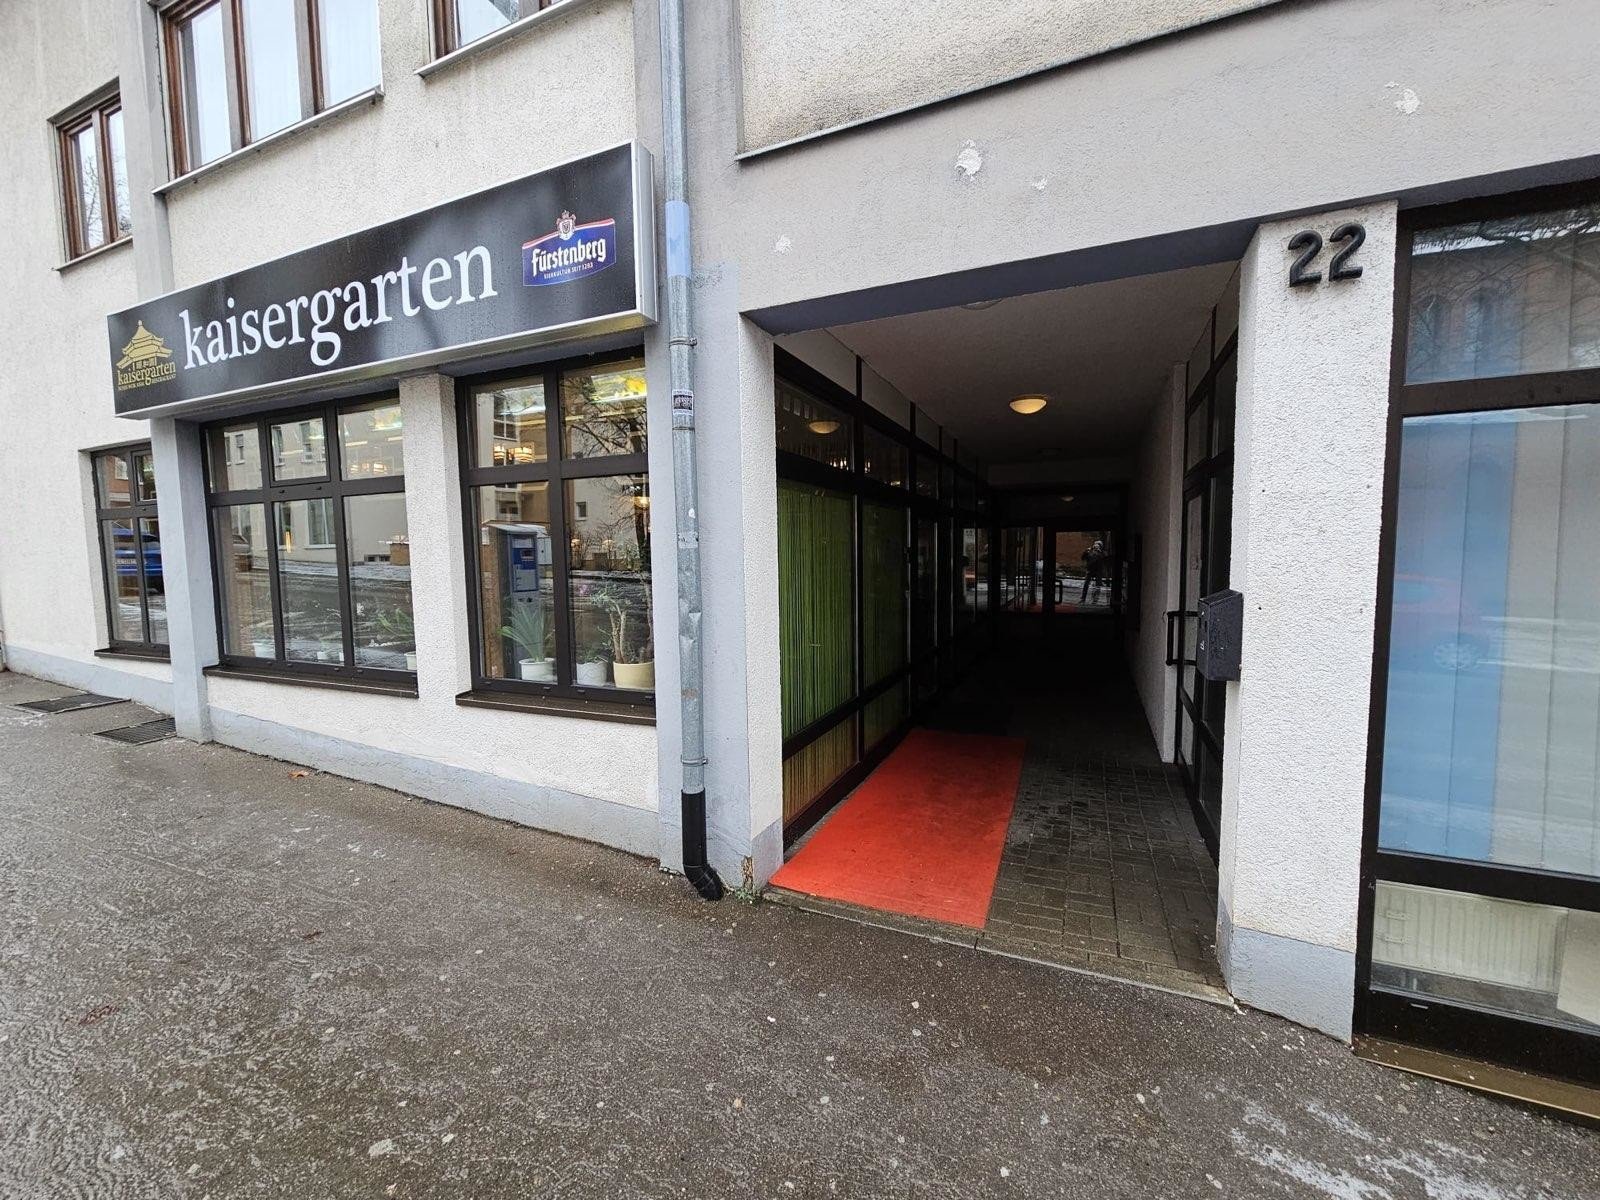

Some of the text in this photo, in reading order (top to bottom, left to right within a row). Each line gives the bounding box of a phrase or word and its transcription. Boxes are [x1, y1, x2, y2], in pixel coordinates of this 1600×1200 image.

[531, 238, 606, 277] Fürstenberg
[1288, 222, 1366, 287] 22
[179, 245, 497, 366] kaisergarten
[117, 361, 176, 386] kaisergarten
